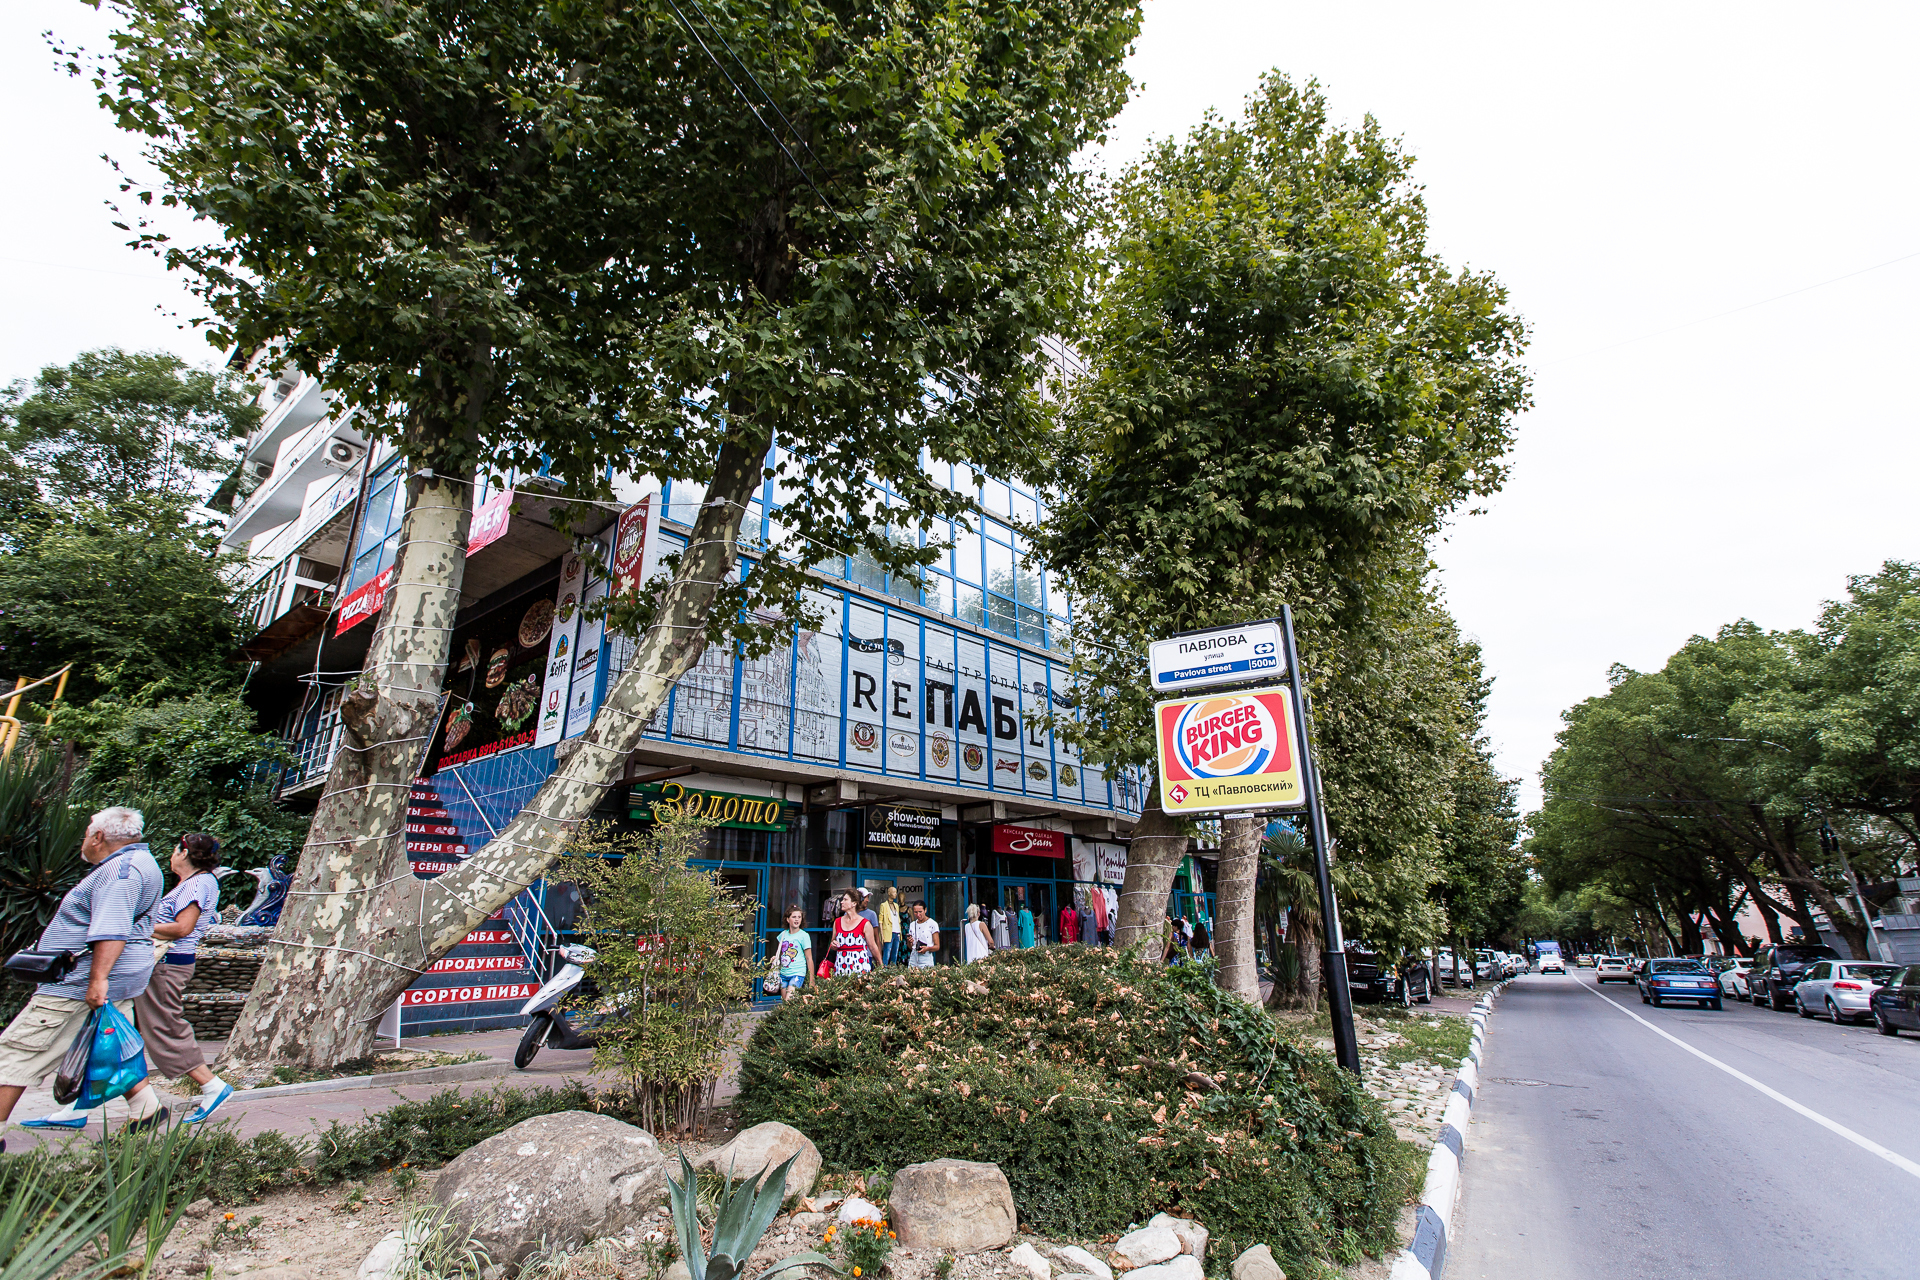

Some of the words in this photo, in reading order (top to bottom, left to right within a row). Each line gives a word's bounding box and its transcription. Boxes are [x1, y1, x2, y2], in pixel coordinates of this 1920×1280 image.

[339, 593, 368, 624] PIZZA
[1179, 634, 1248, 654] ПАВЛОВА
[1204, 652, 1225, 662] улица
[1251, 657, 1277, 669] 500м
[549, 659, 568, 678] Leffe
[1174, 668, 1207, 679] Pavlova
[1208, 664, 1233, 674] street
[1186, 705, 1258, 746] BURGER
[1191, 720, 1263, 768] KING
[437, 747, 478, 772] ДОСТАВКА
[1194, 786, 1210, 798] ТЦ
[1212, 780, 1293, 796] «Павловский»
[654, 781, 780, 825] Золото
[888, 810, 940, 826] show-room
[868, 831, 907, 845] ЖЕНСКАЯ
[909, 835, 941, 849] ОДЕЖДА
[1003, 828, 1024, 836] ЖЕНСКАЯ
[1098, 846, 1127, 869] Monika
[466, 932, 495, 942] ЫБА
[428, 957, 515, 971] ПРОДУКТЫ
[411, 987, 483, 1004] СОРТОВ
[486, 984, 531, 999] ПИВА
